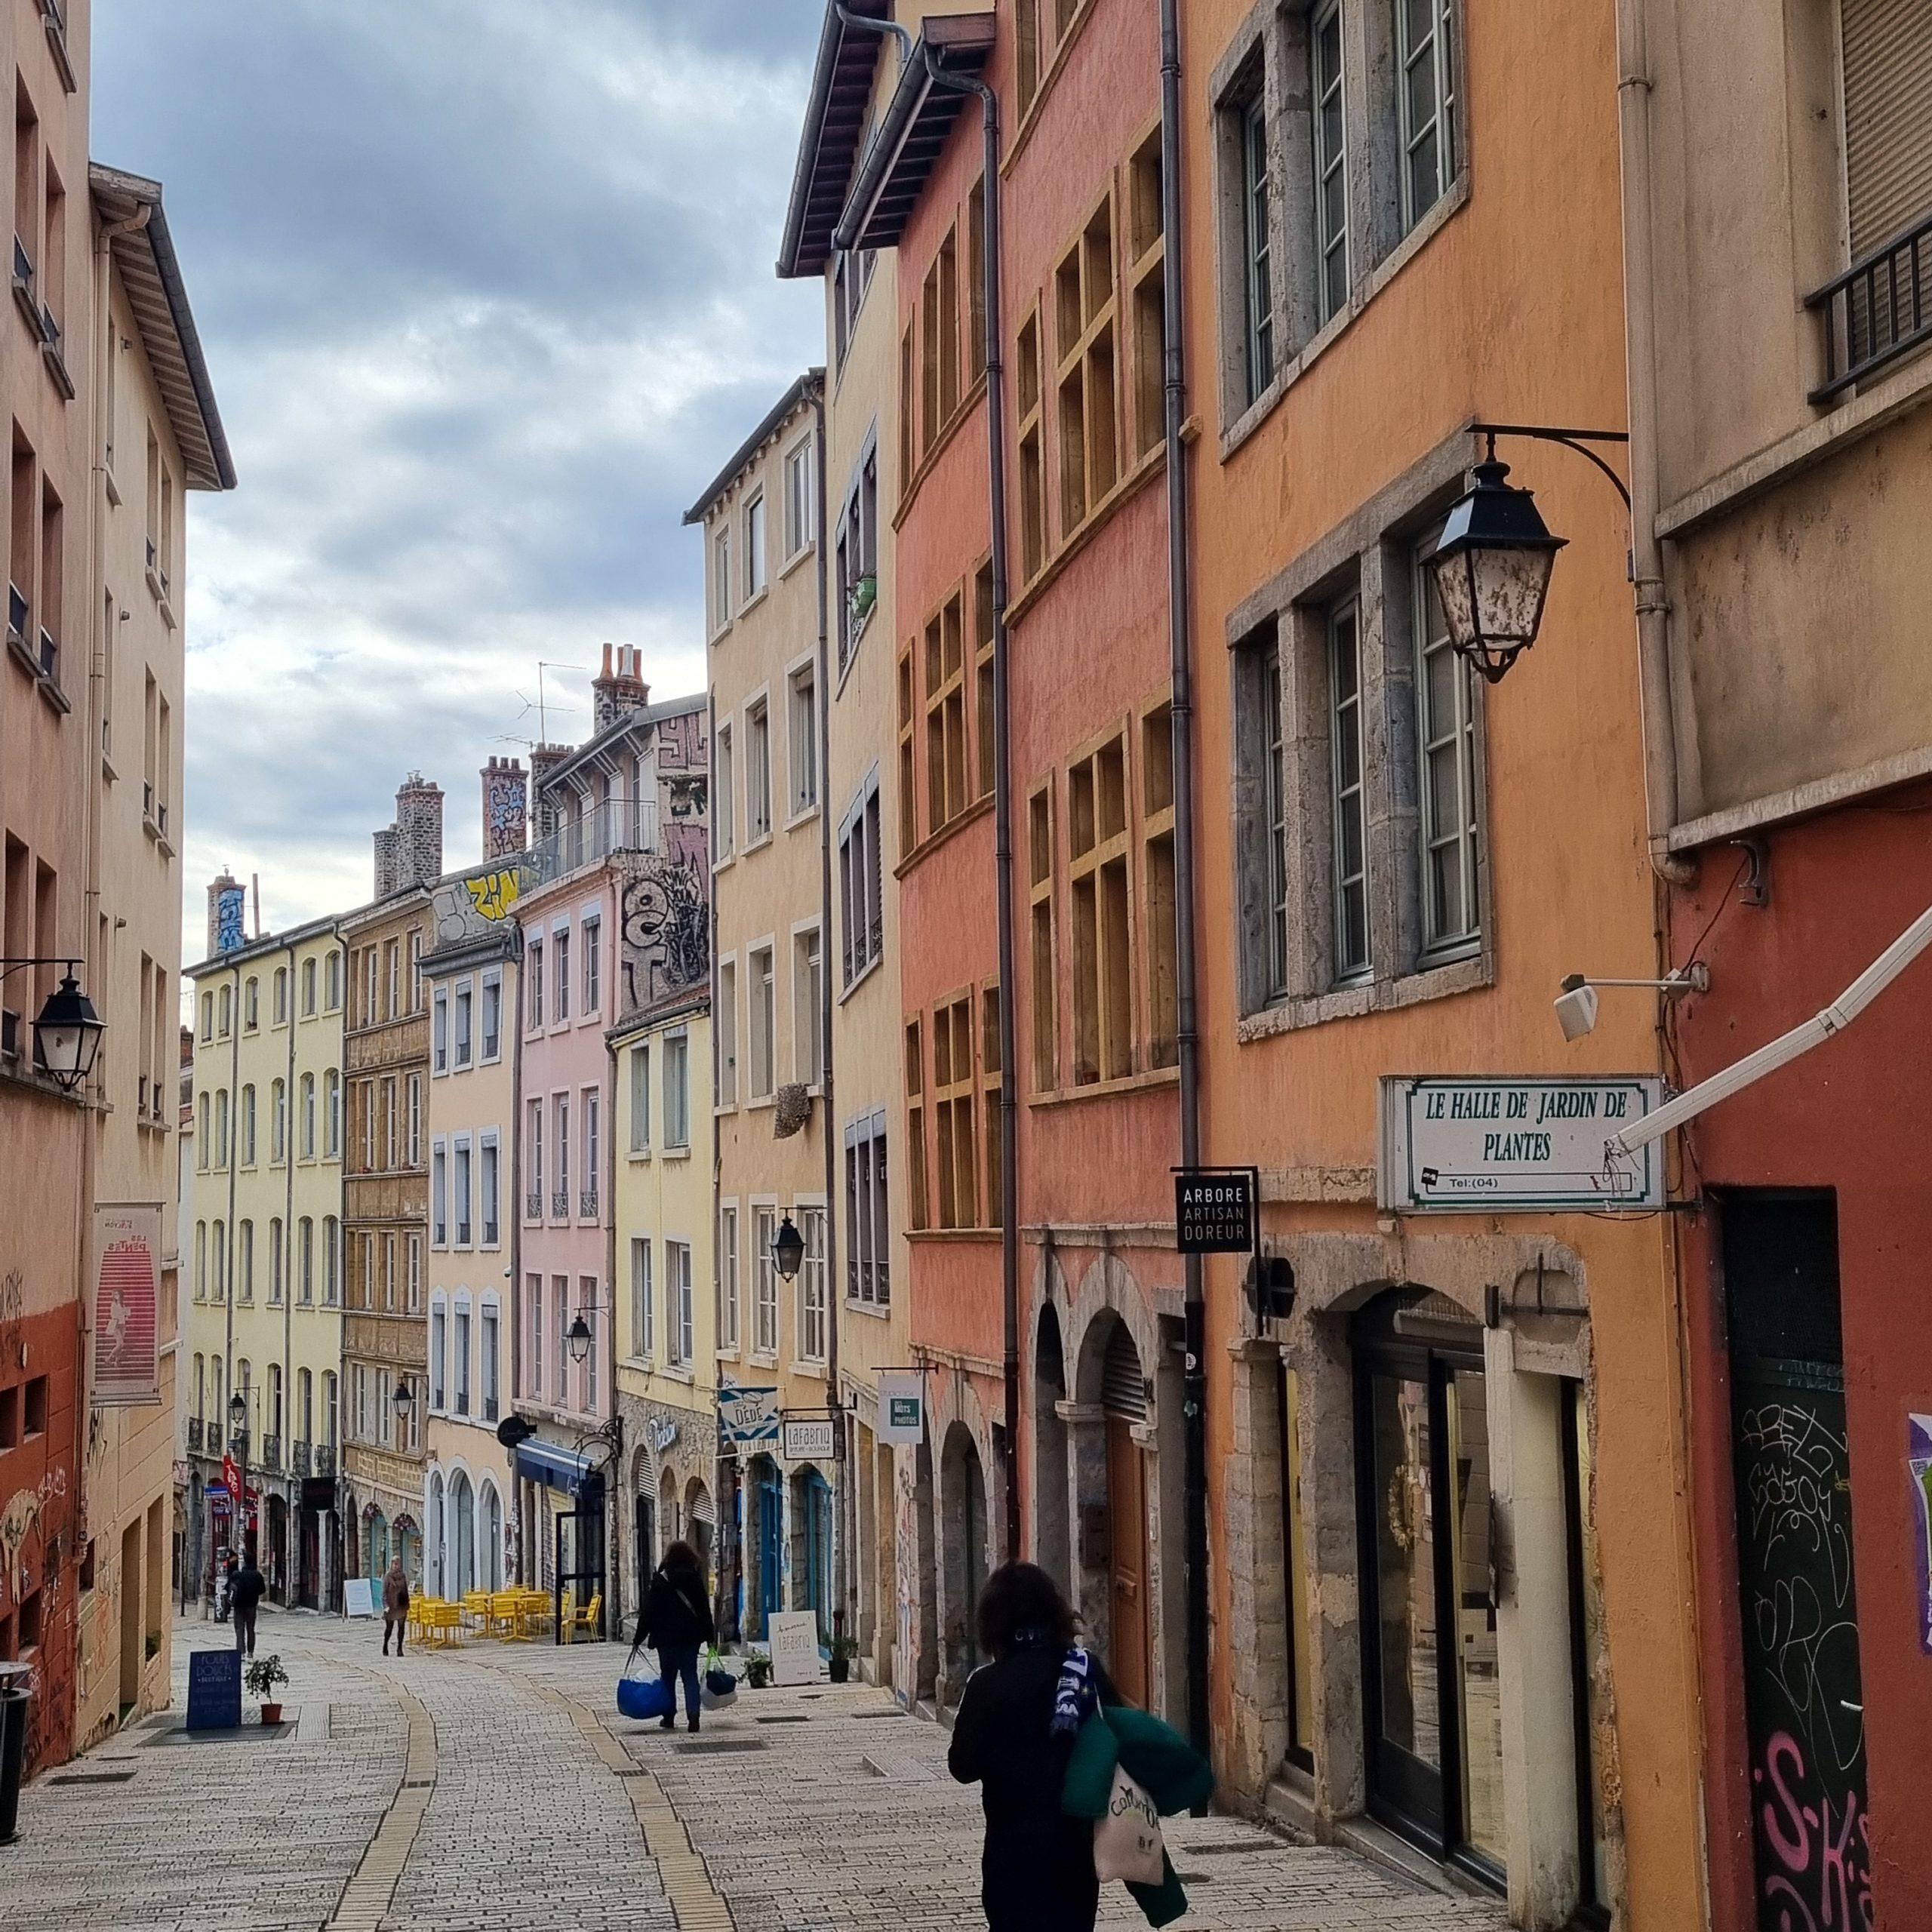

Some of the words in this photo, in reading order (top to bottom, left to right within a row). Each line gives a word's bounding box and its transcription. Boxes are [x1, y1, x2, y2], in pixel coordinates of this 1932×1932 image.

[1426, 1092, 1444, 1119] LE
[1451, 1091, 1500, 1118] HALLE
[1506, 1091, 1527, 1118] DE
[1537, 1091, 1598, 1124] JARDIN
[1604, 1091, 1627, 1118] DE
[1483, 1132, 1552, 1161] PLANTES
[1183, 1188, 1244, 1204] ARBORE
[1184, 1206, 1244, 1221] ARTISAN
[1185, 1224, 1244, 1241] DOREUR
